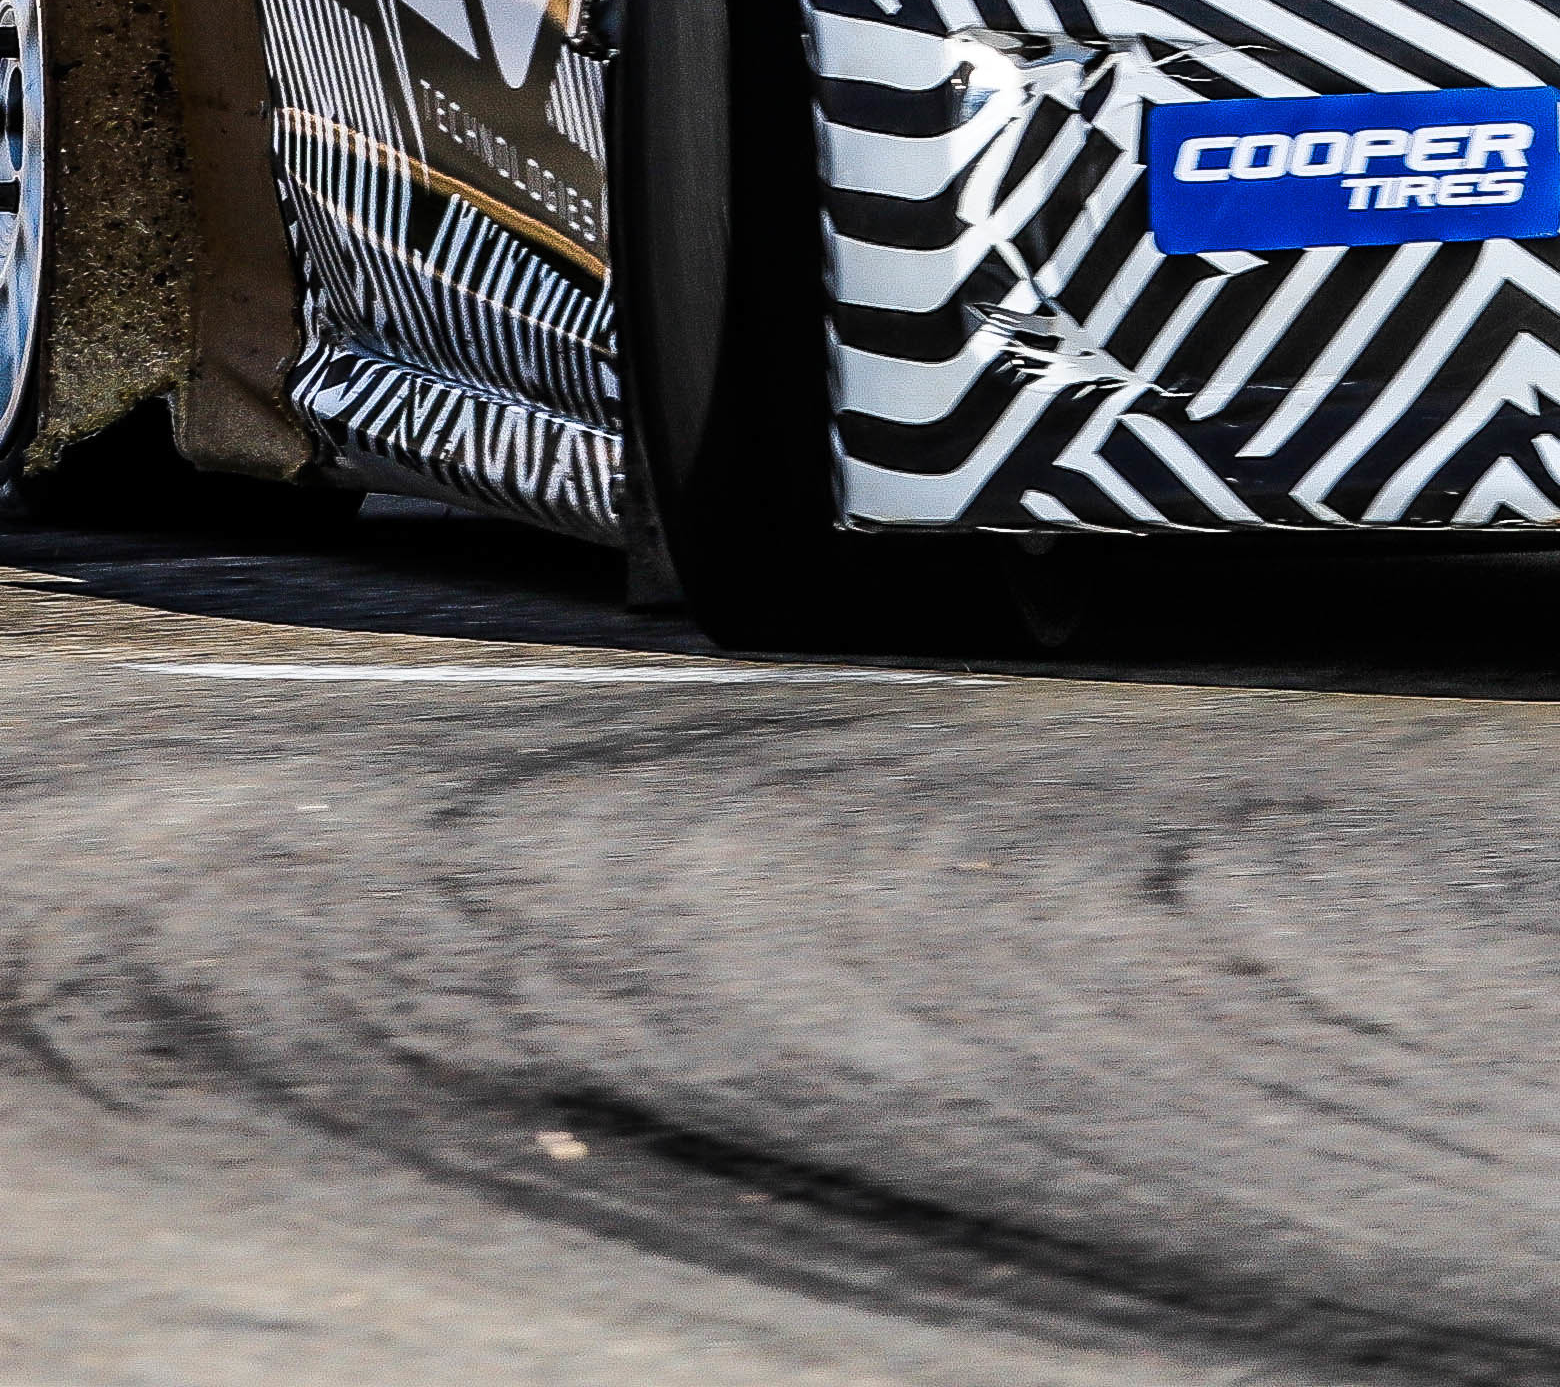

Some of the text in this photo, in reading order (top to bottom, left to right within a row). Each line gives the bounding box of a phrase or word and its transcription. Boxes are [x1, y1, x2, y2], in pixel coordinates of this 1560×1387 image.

[419, 78, 598, 243] TECHNOLOGIES
[1172, 121, 1536, 183] COOPER
[1339, 170, 1529, 211] TIRES
